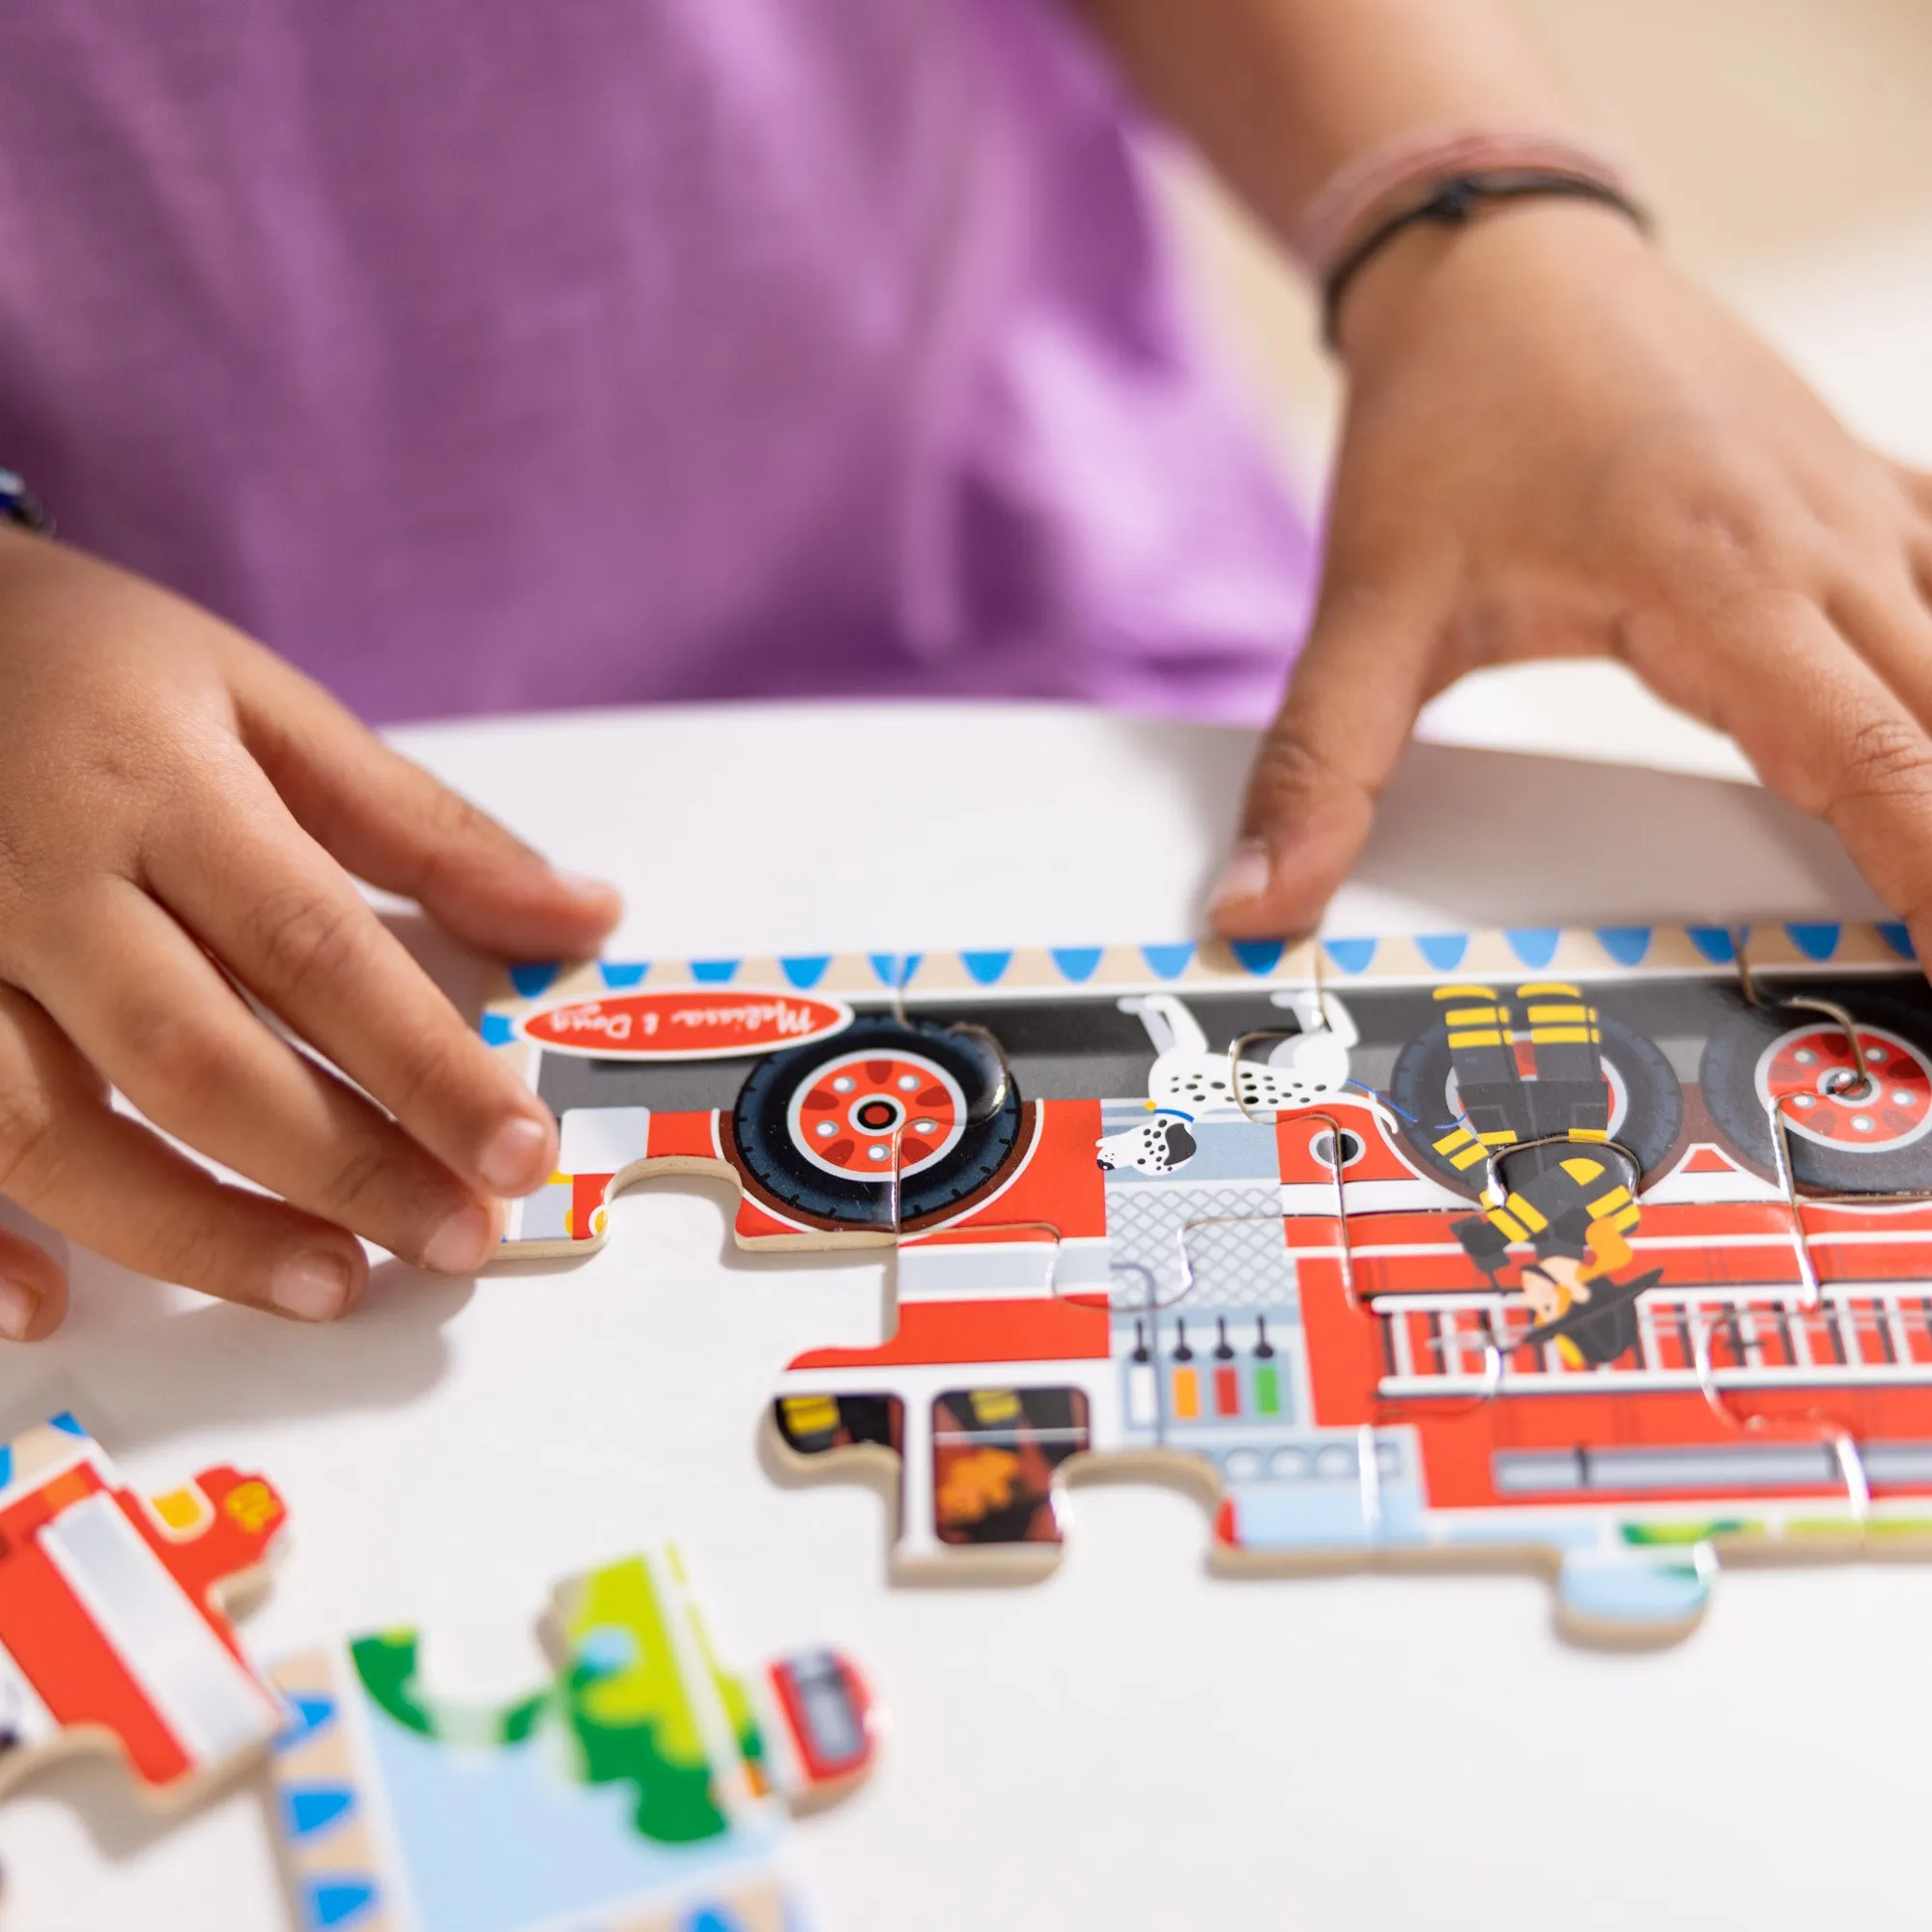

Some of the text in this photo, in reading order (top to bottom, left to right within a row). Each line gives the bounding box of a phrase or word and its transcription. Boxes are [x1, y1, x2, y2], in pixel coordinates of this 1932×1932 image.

[550, 1000, 814, 1039] Melissa & Doug
